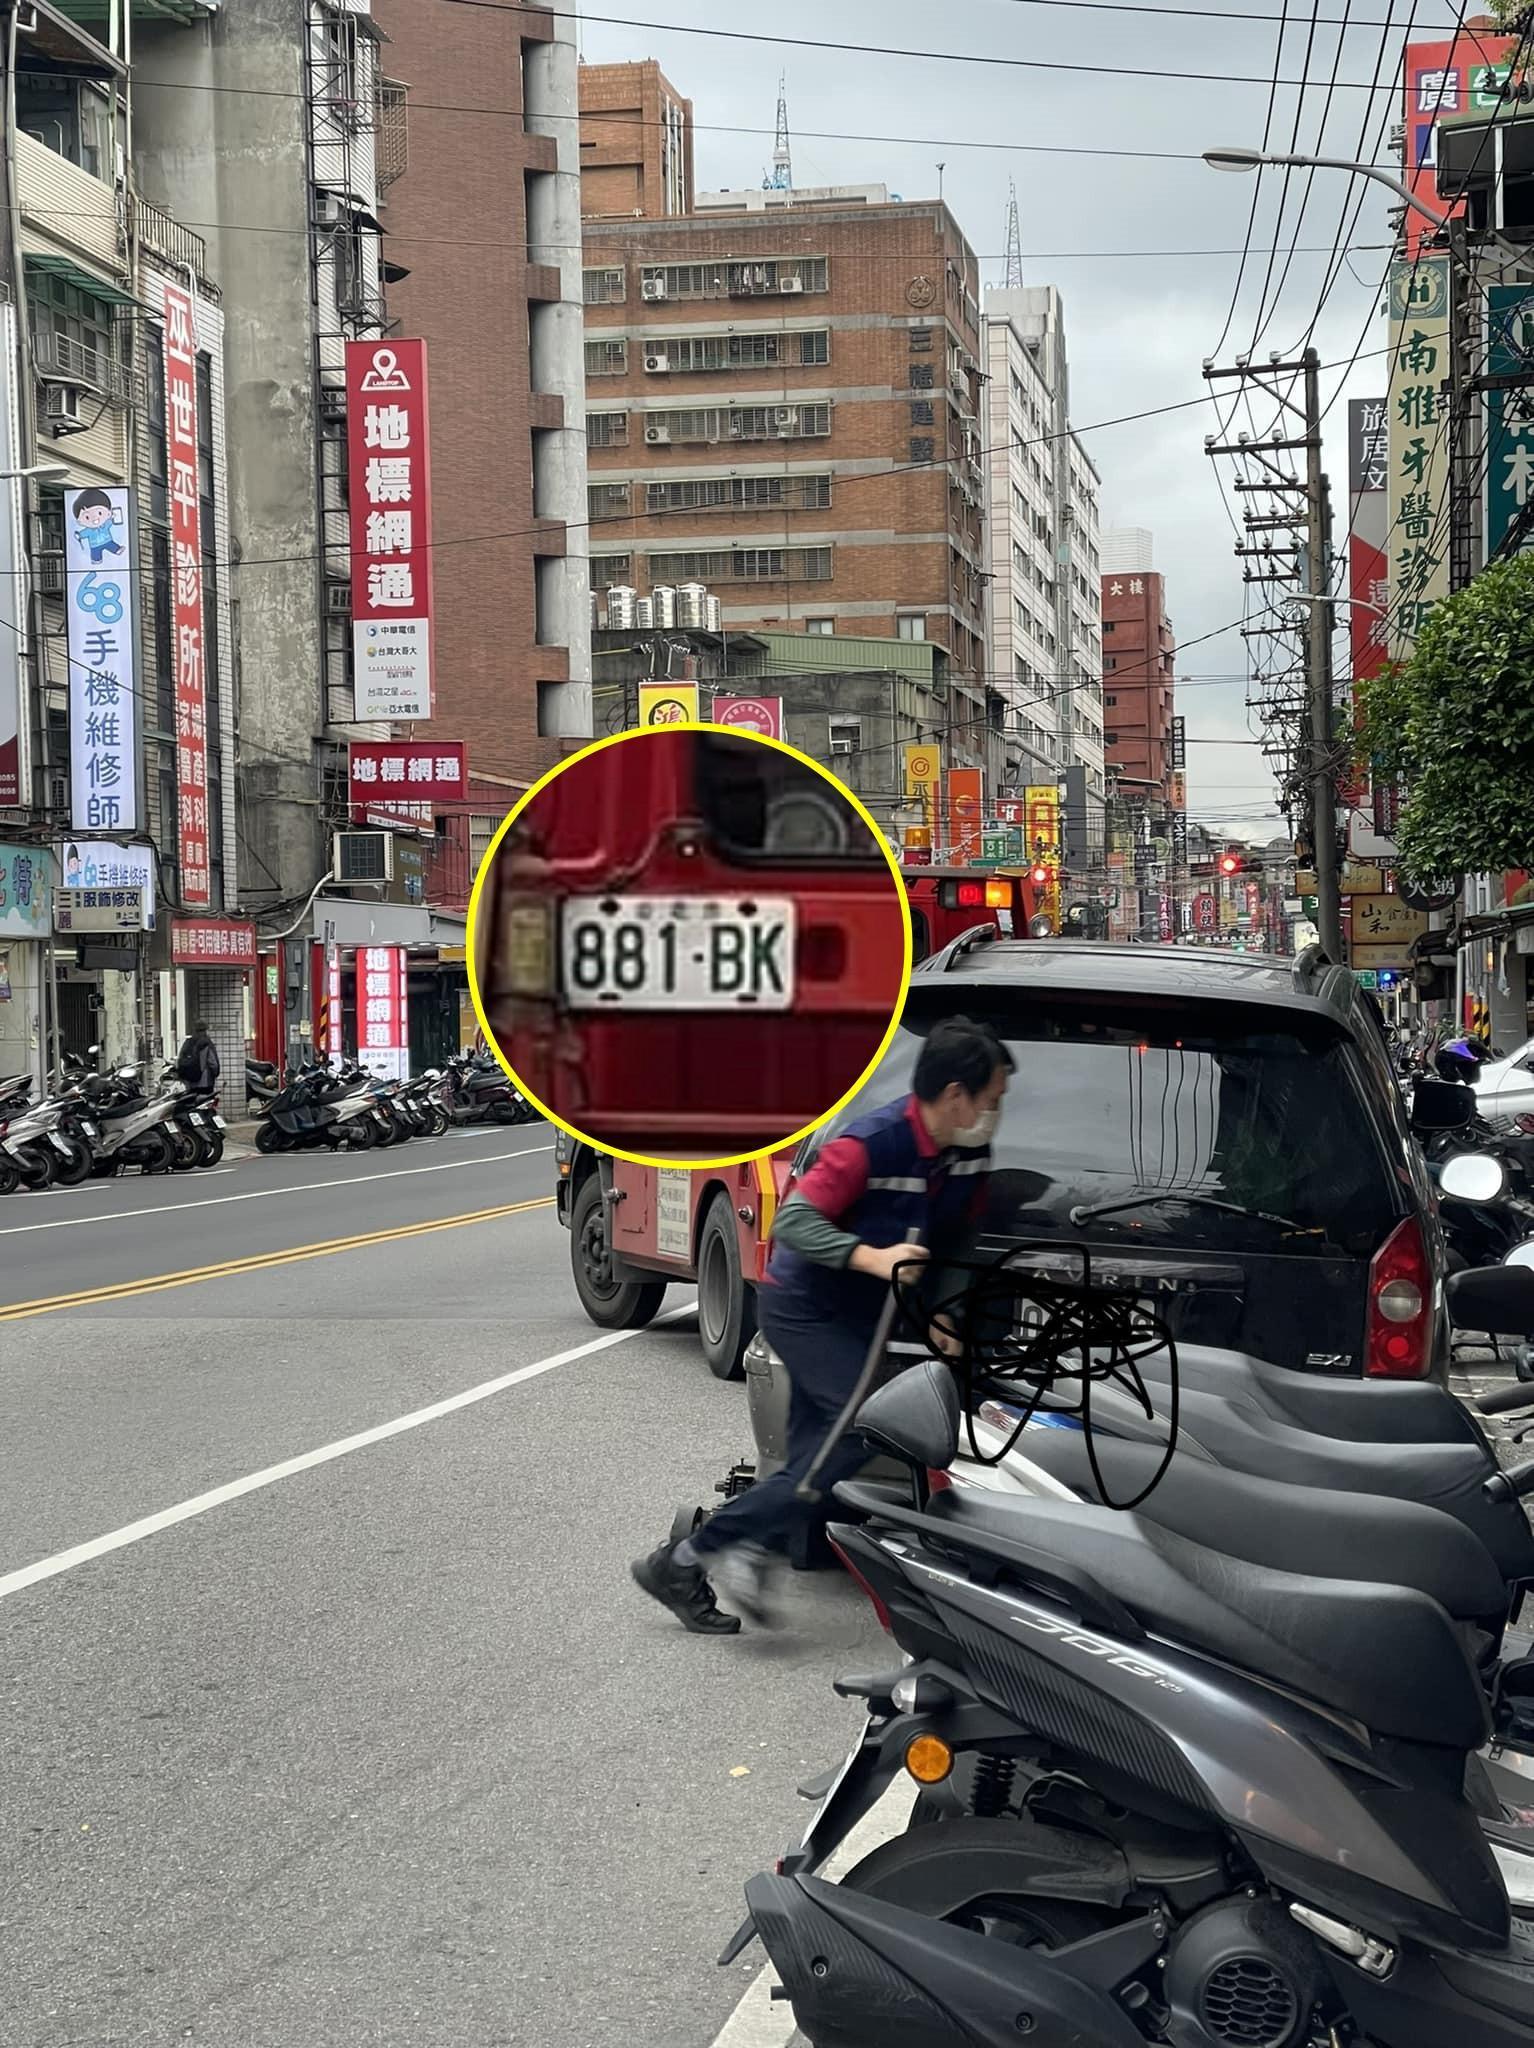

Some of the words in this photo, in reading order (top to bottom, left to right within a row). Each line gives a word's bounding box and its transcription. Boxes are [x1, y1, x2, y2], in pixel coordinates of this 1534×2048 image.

[364, 404, 415, 609] 地標網通
[1396, 329, 1442, 643] 南雅牙醫診所
[83, 628, 121, 828] 手機維修師
[352, 757, 461, 782] 地標網通
[83, 891, 140, 908] 服飾修改
[365, 948, 392, 1047] 地標網通
[1032, 1267, 1179, 1292] AVRIN
[1010, 1615, 1166, 1679] JOG
[1153, 1676, 1185, 1694] 125
